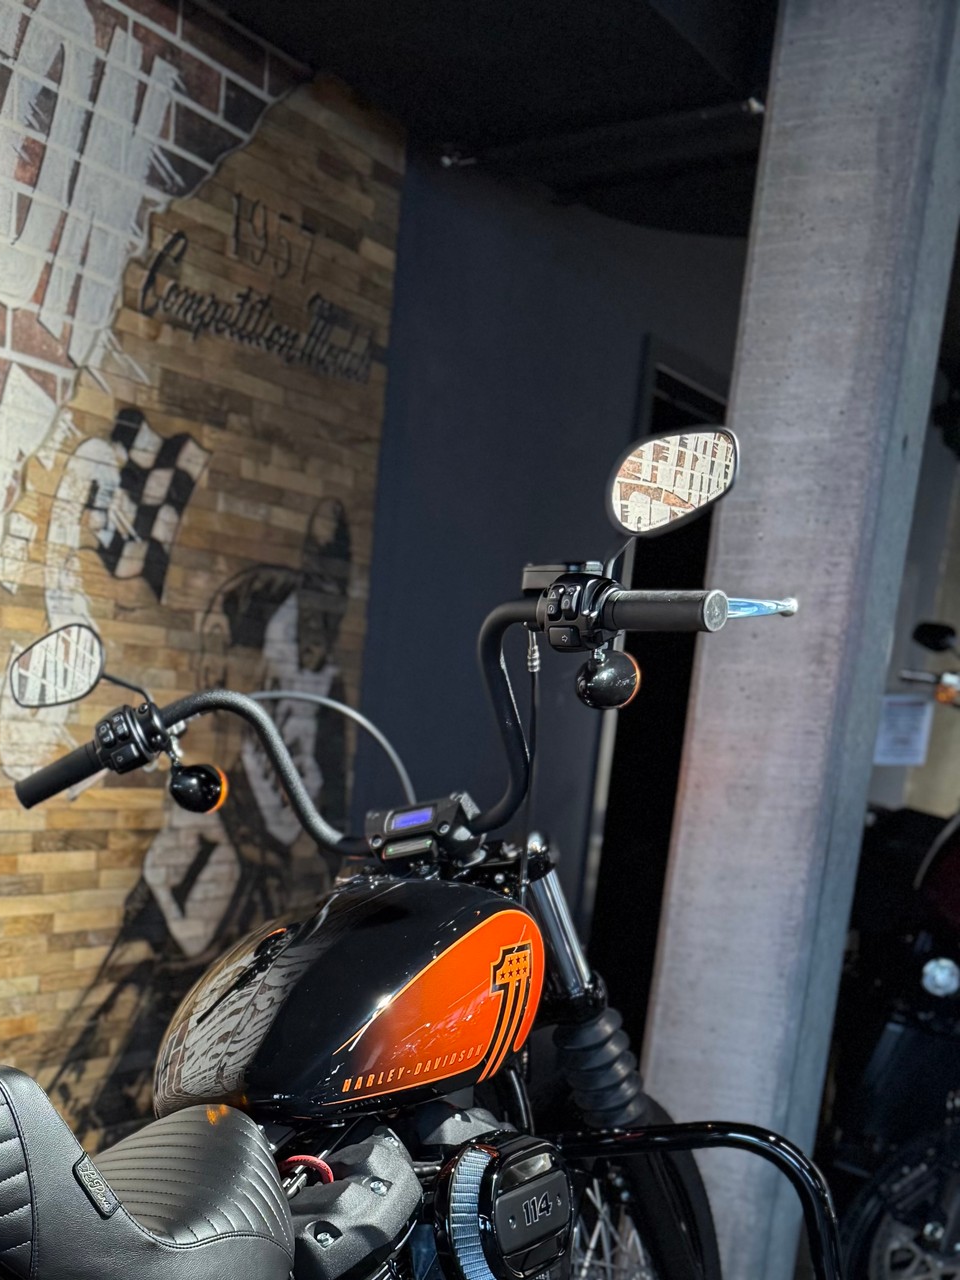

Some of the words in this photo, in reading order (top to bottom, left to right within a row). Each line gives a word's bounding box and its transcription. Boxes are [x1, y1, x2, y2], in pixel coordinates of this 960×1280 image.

[140, 227, 299, 362] Competition
[342, 1043, 484, 1093] HARLEY-DAVIDSON
[522, 1191, 553, 1227] 114
